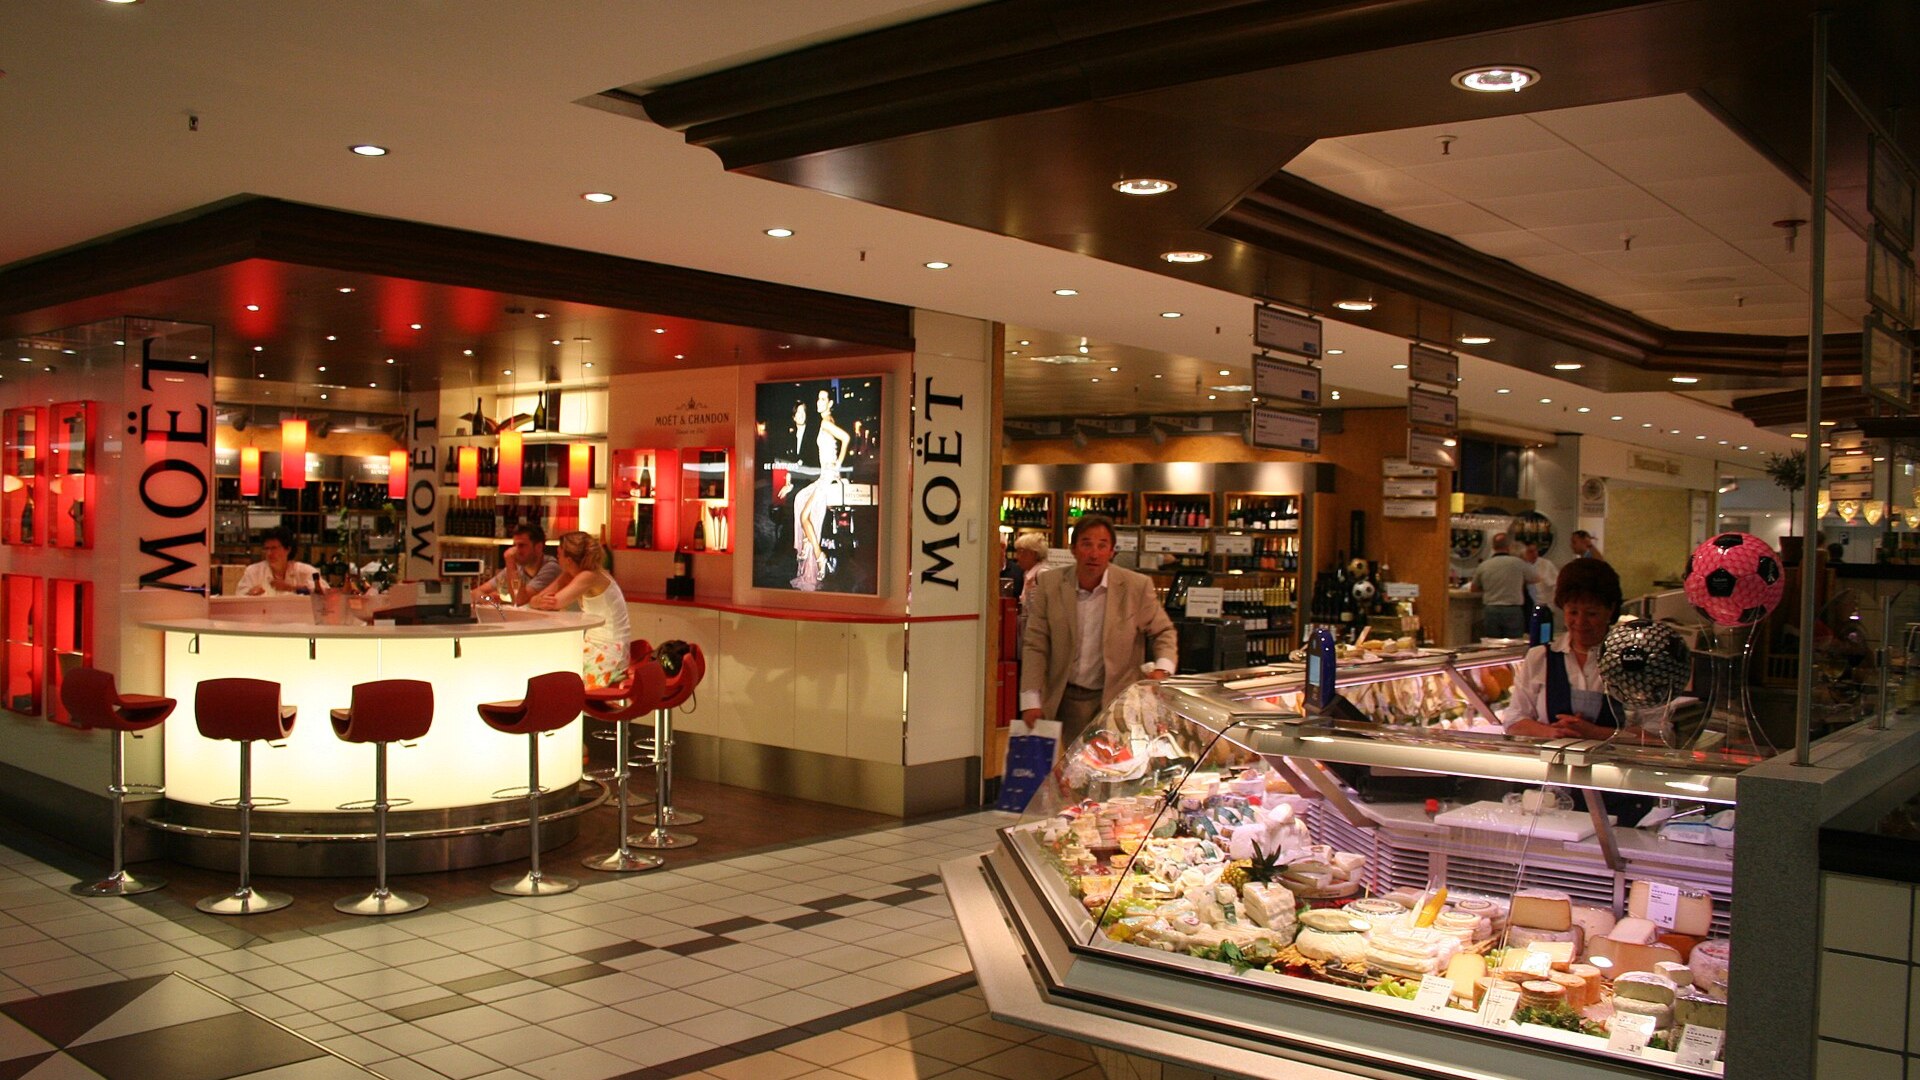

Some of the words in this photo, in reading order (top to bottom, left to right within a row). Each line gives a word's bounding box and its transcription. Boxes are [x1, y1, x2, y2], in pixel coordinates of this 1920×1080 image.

[127, 337, 210, 599] MOËT
[409, 407, 437, 566] MOËT
[680, 415, 686, 425] &
[688, 412, 729, 425] CHANDON
[915, 376, 963, 592] MOËT
